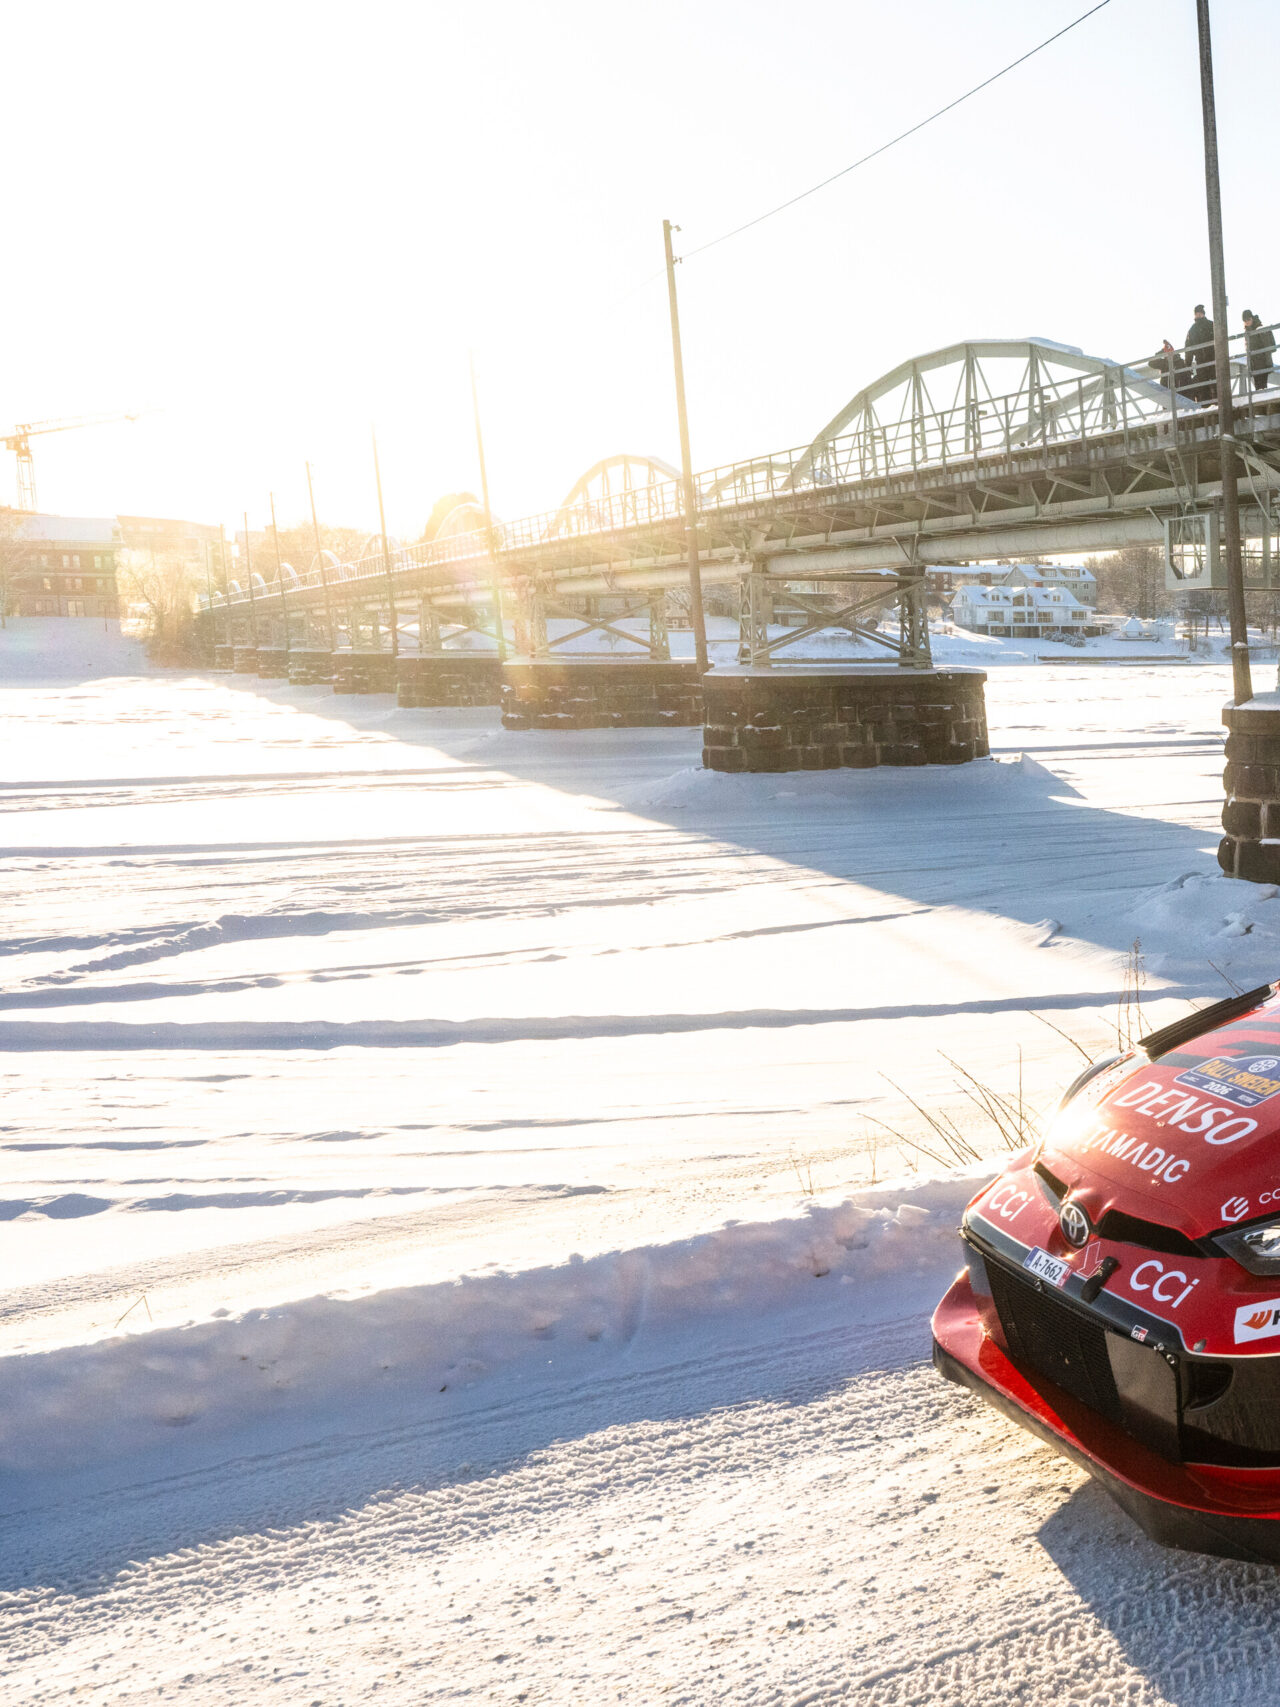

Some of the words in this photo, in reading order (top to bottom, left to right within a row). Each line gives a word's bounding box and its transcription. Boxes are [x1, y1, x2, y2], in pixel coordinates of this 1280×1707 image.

[1196, 1060, 1241, 1080] RALLY
[1202, 1081, 1233, 1096] 2026
[1113, 1081, 1259, 1145] DENSO
[1032, 1254, 1063, 1281] A-7662
